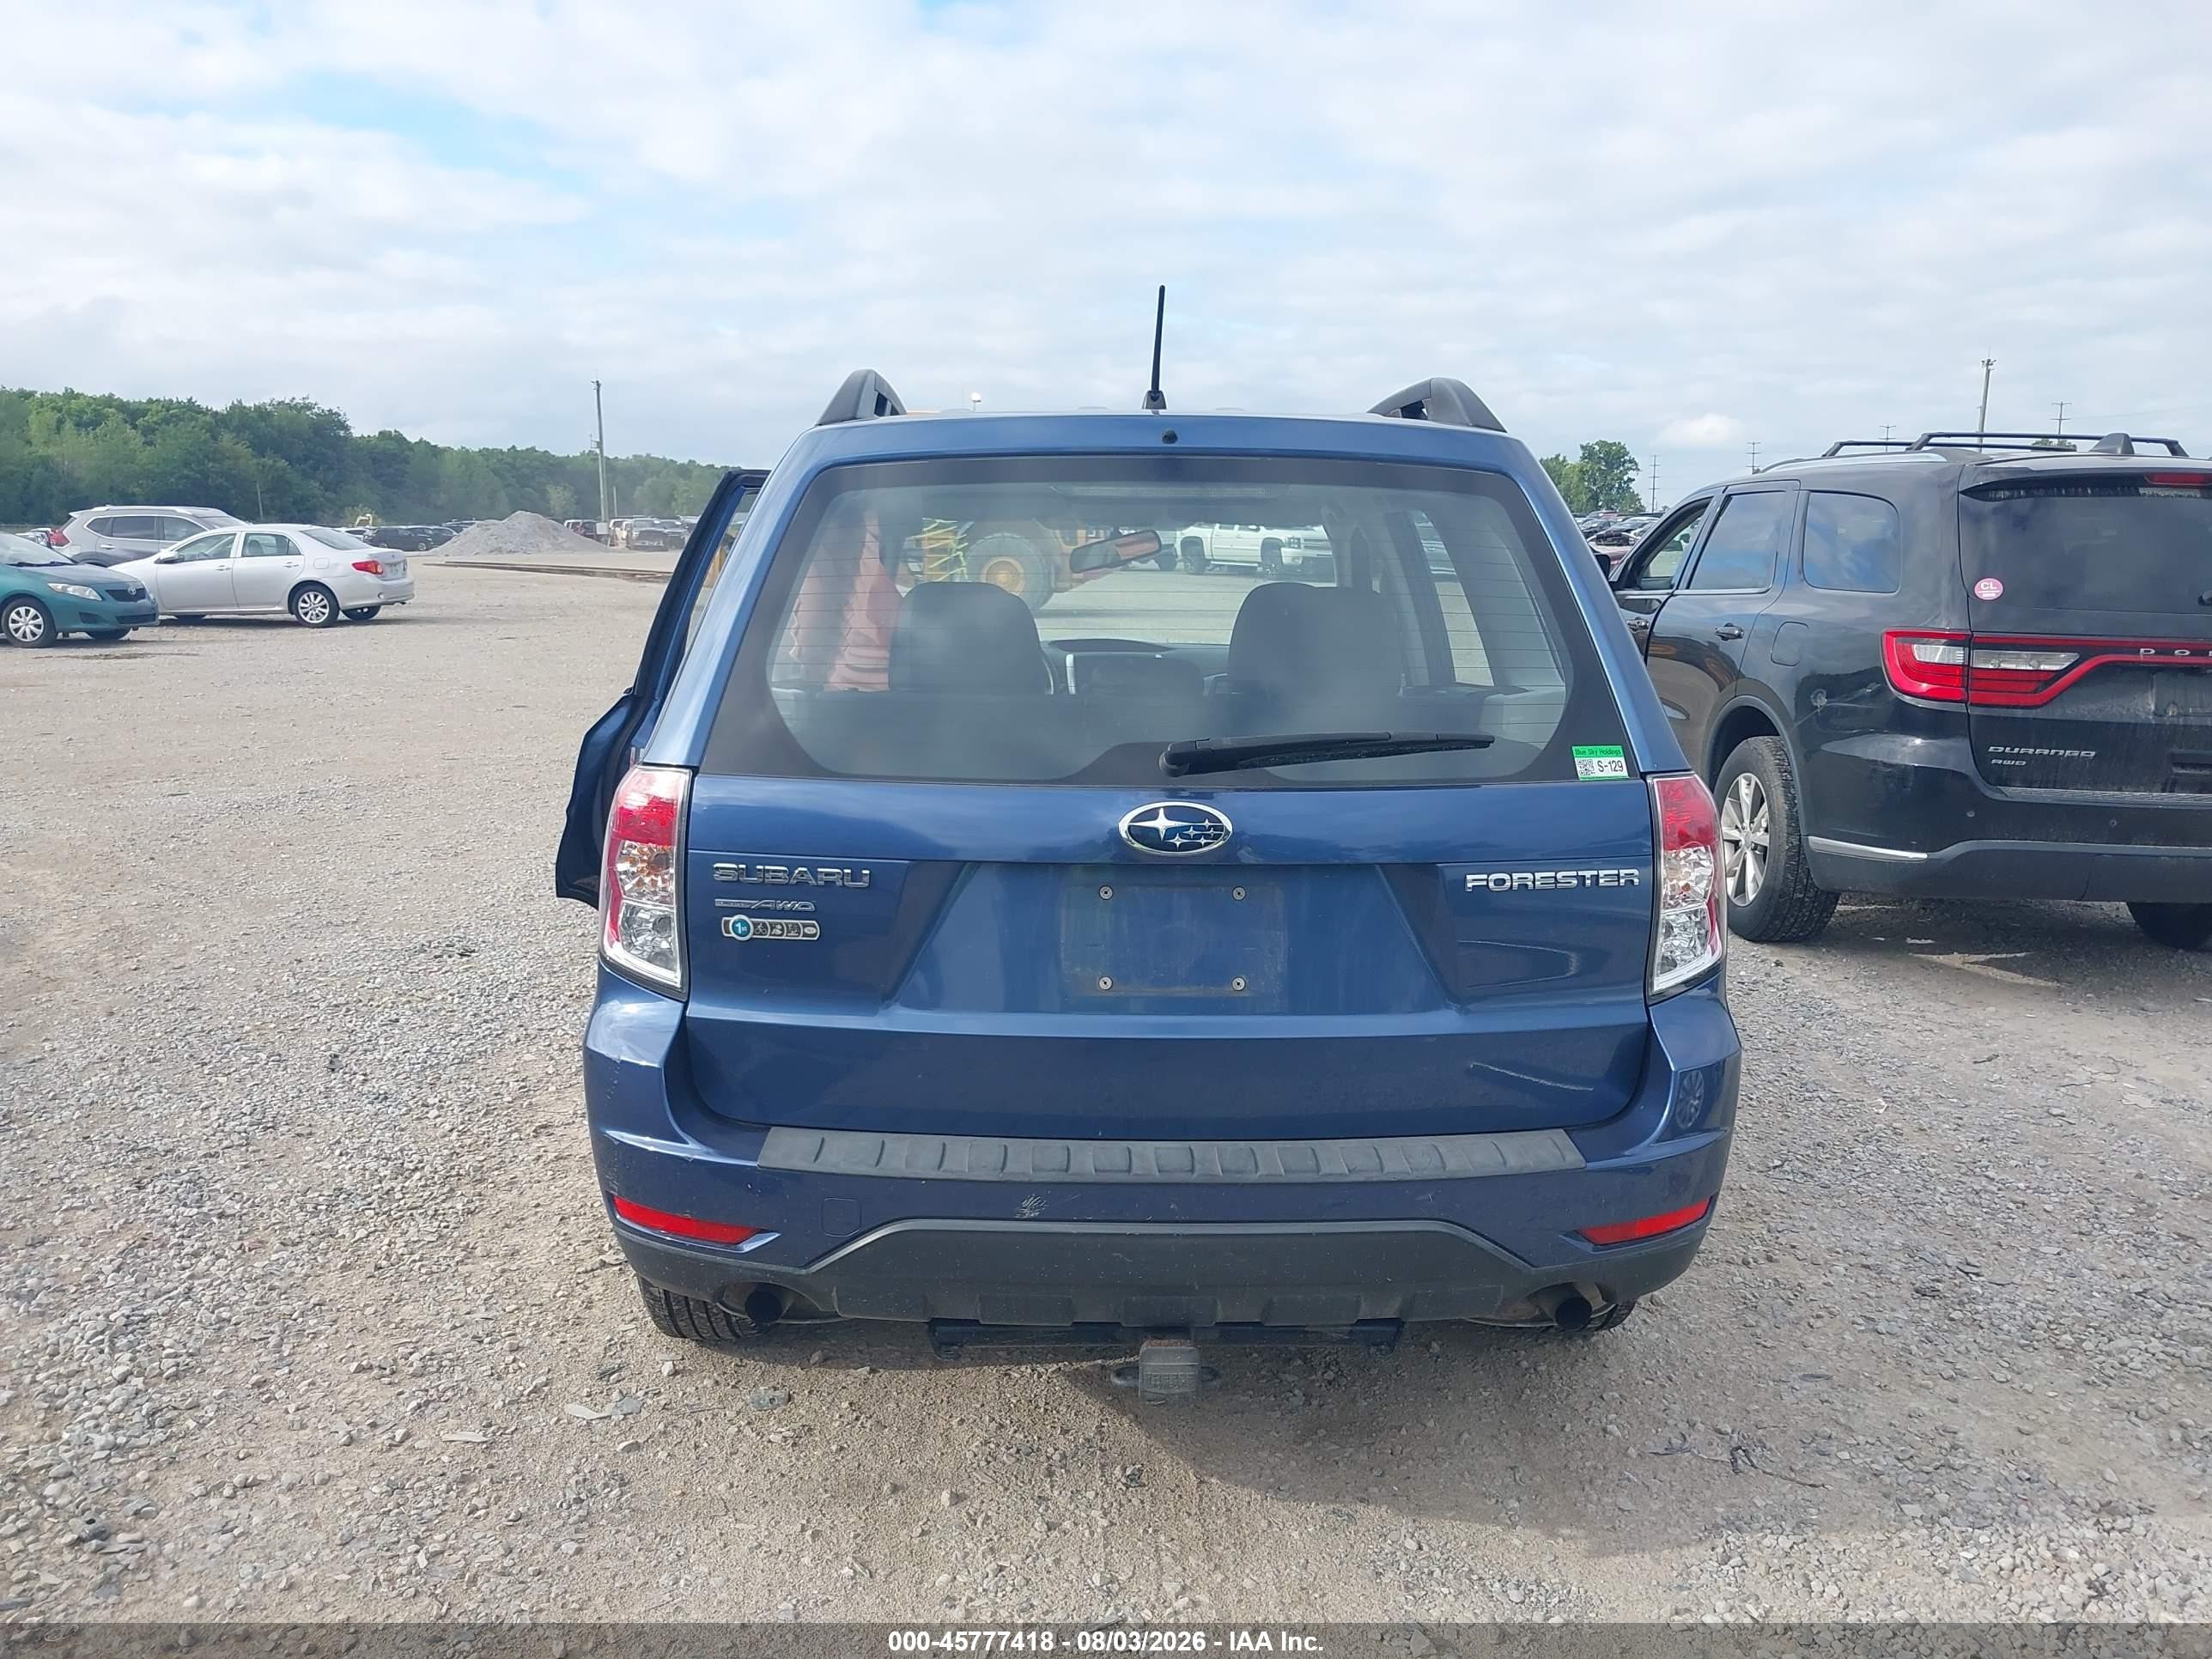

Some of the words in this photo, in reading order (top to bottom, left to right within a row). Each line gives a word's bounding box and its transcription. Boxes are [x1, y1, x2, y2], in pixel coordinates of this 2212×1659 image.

[1988, 746, 2095, 757] DURANGO
[1597, 760, 1624, 772] S-129
[713, 862, 871, 888] SUBARU
[1465, 868, 1640, 892] FORESTER
[750, 899, 816, 912] AWD
